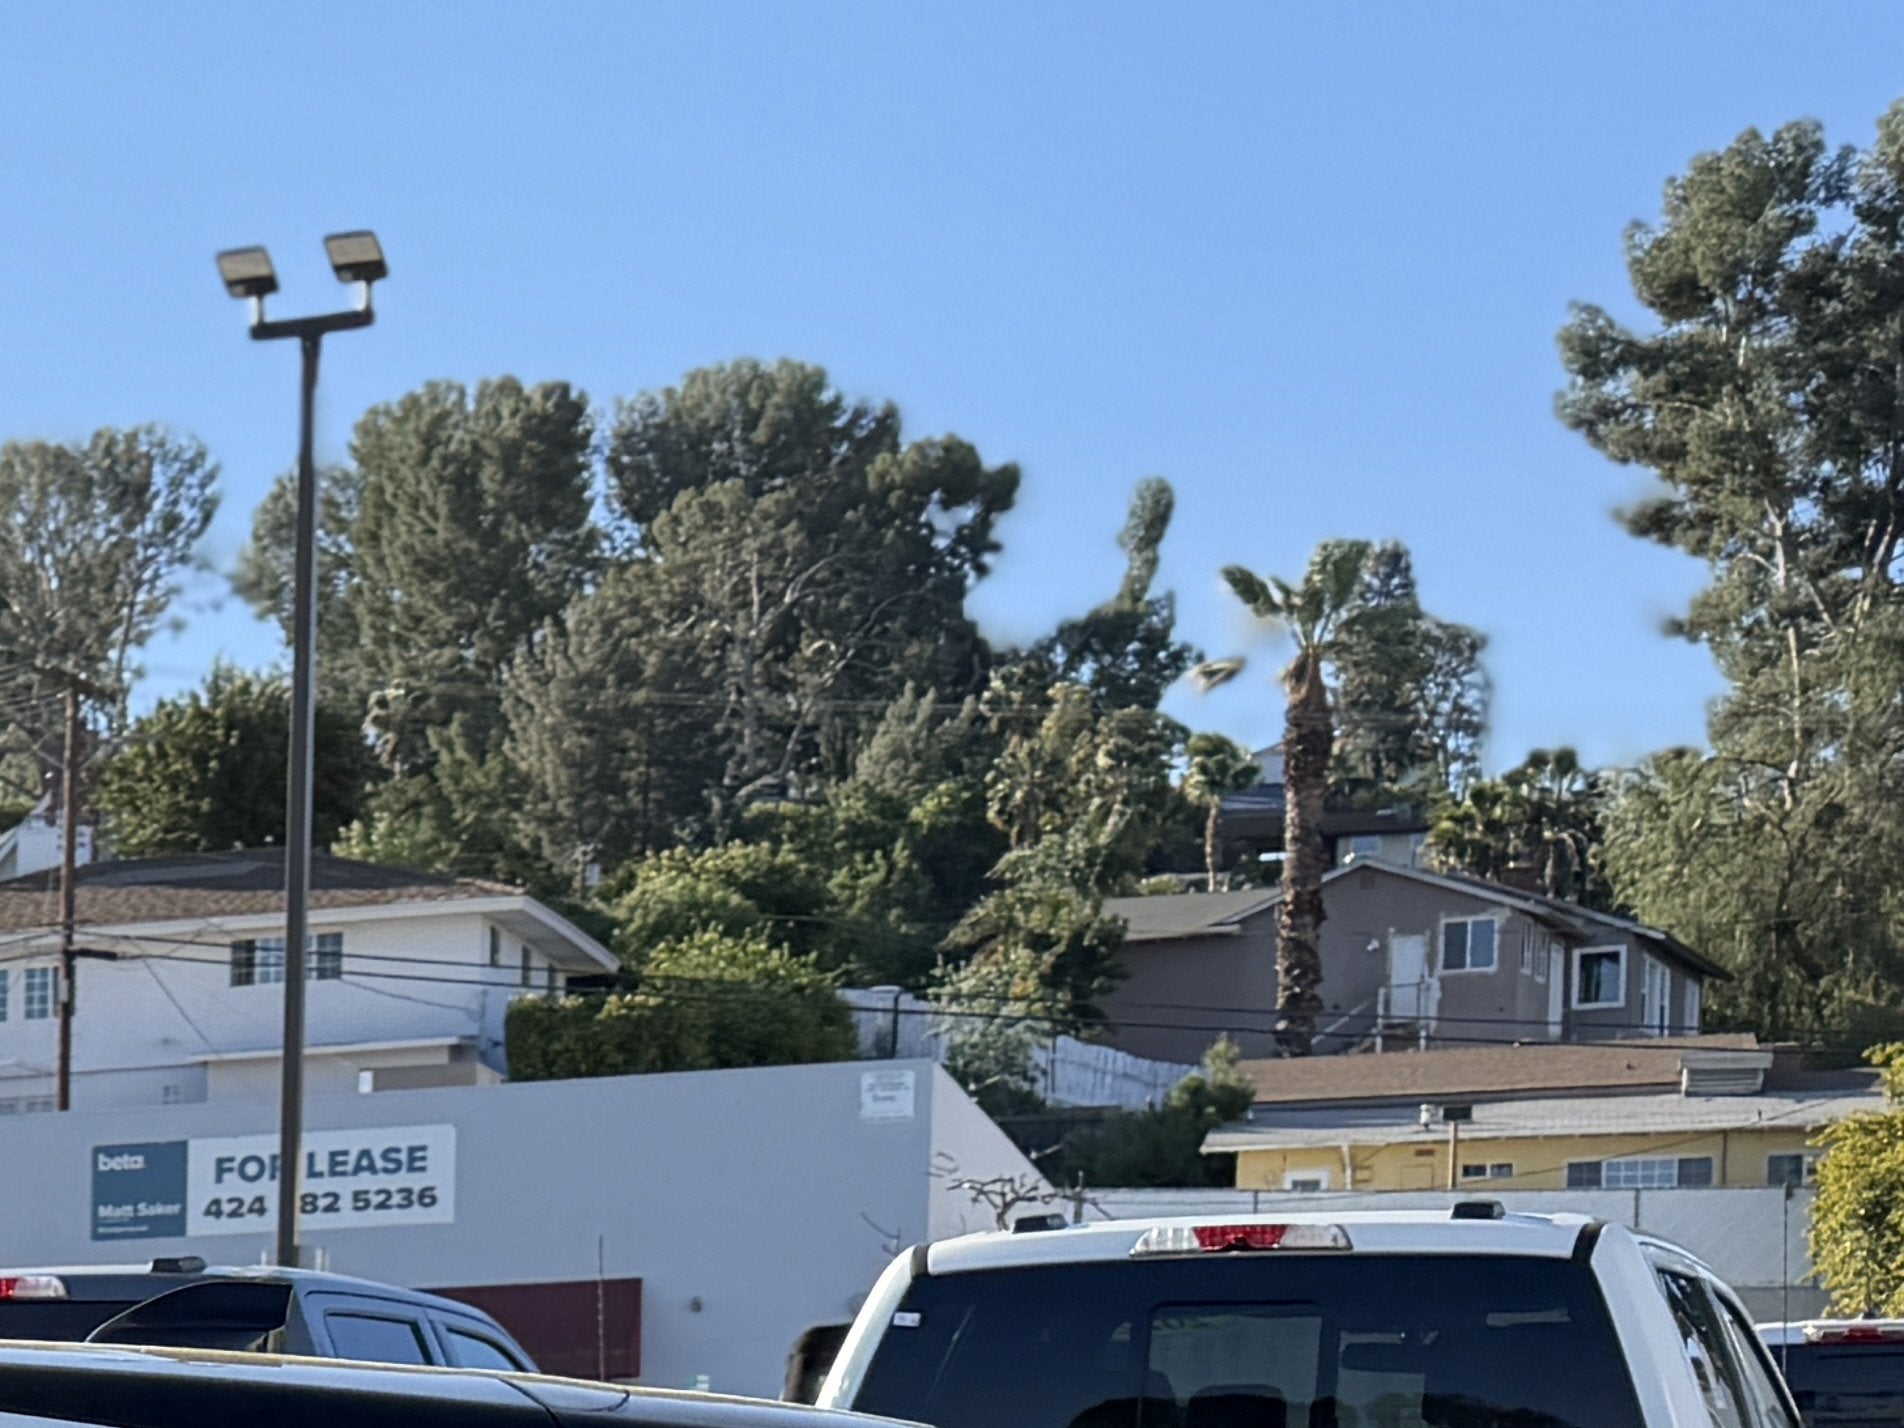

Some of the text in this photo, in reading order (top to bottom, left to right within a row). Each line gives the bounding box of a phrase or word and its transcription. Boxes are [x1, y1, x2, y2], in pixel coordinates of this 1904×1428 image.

[305, 1145, 428, 1180] LEASE
[203, 1186, 438, 1220] 424 82 5236
